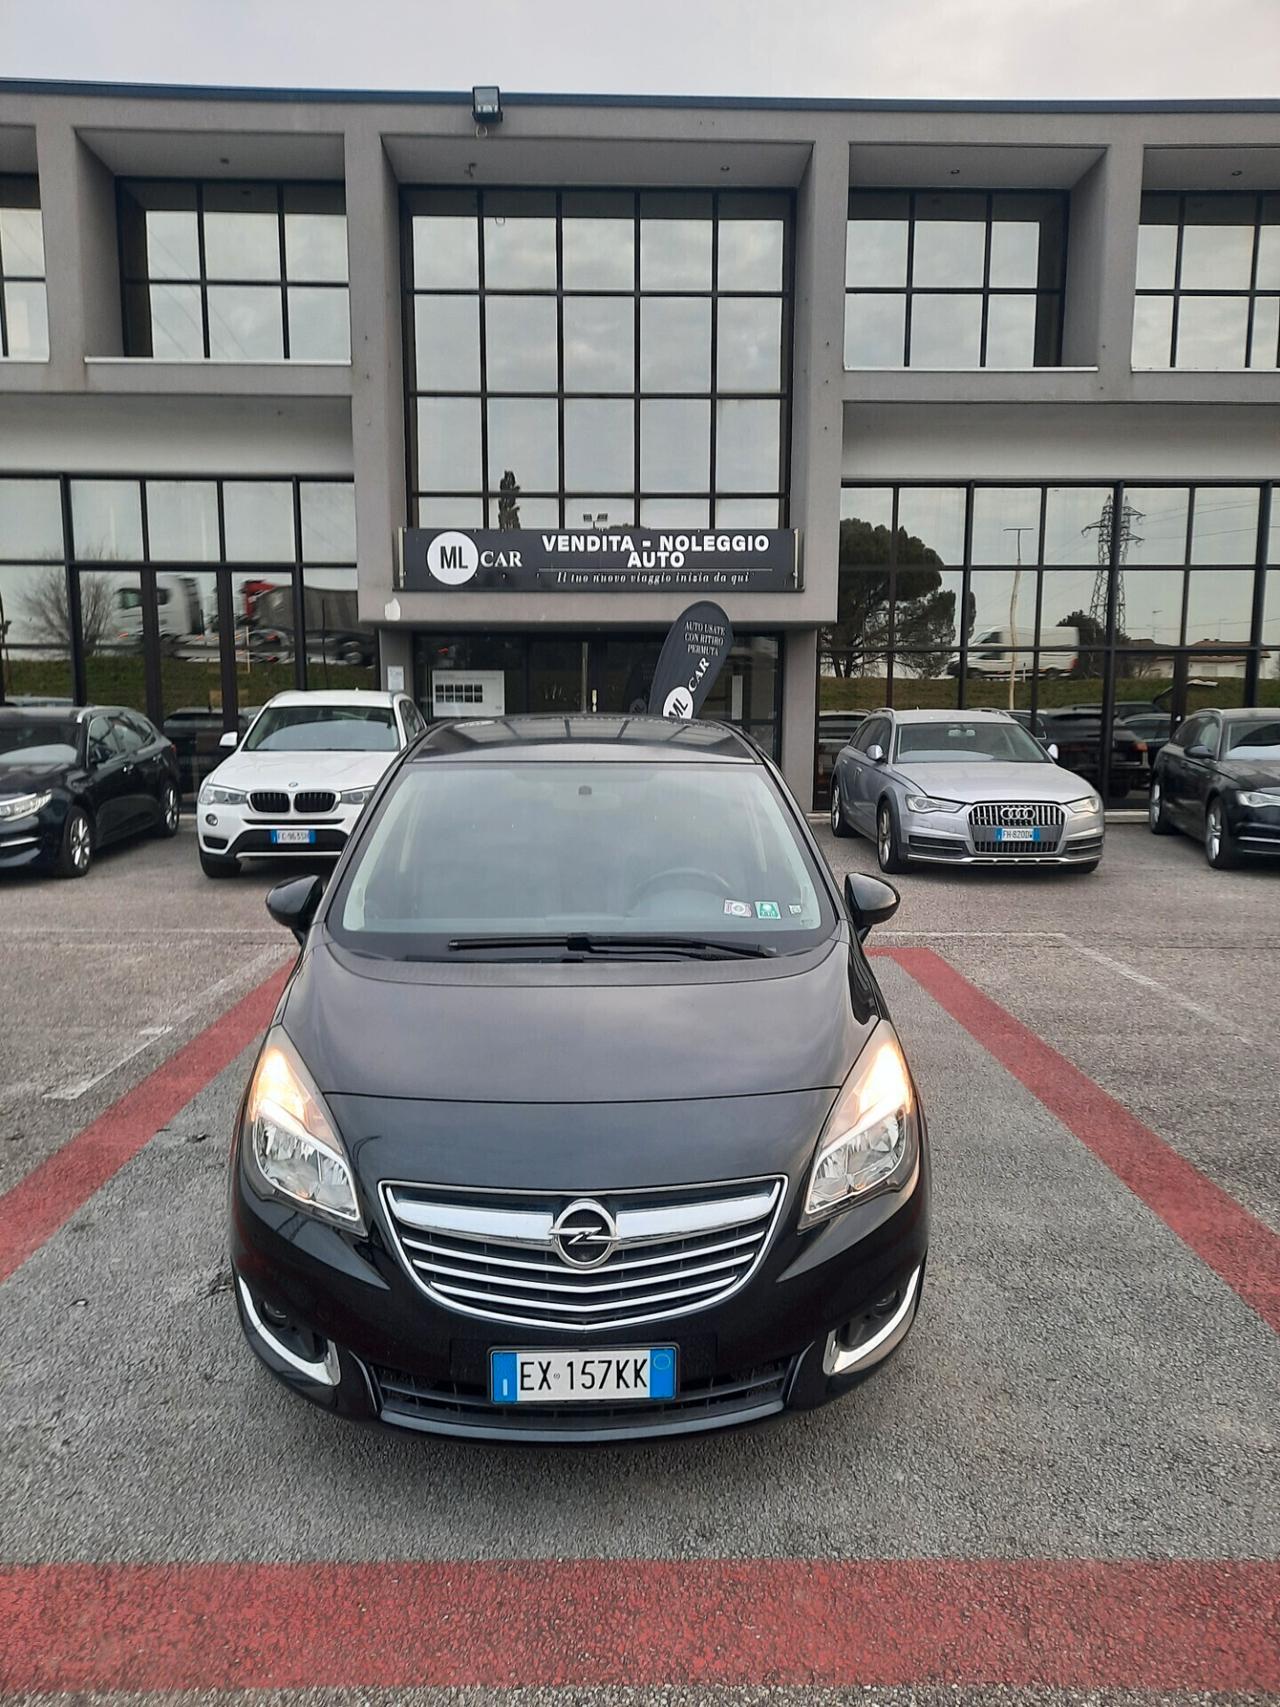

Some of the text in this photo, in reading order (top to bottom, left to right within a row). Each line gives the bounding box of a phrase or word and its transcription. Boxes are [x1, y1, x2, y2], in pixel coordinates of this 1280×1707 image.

[541, 535, 635, 552] VENDITA
[660, 535, 770, 552] NOLEGGIO
[440, 545, 523, 570] ML CAR
[627, 551, 685, 568] AUTO
[557, 571, 751, 586] Il tuo nuovo viaggio inizia da qui
[684, 621, 726, 636] AUTO USATE
[684, 632, 724, 646] CON RITIRO
[687, 643, 719, 656] PERMUTA
[668, 657, 710, 717] ML CAR
[519, 1360, 552, 1391] EX
[566, 1358, 648, 1391] 157KK
